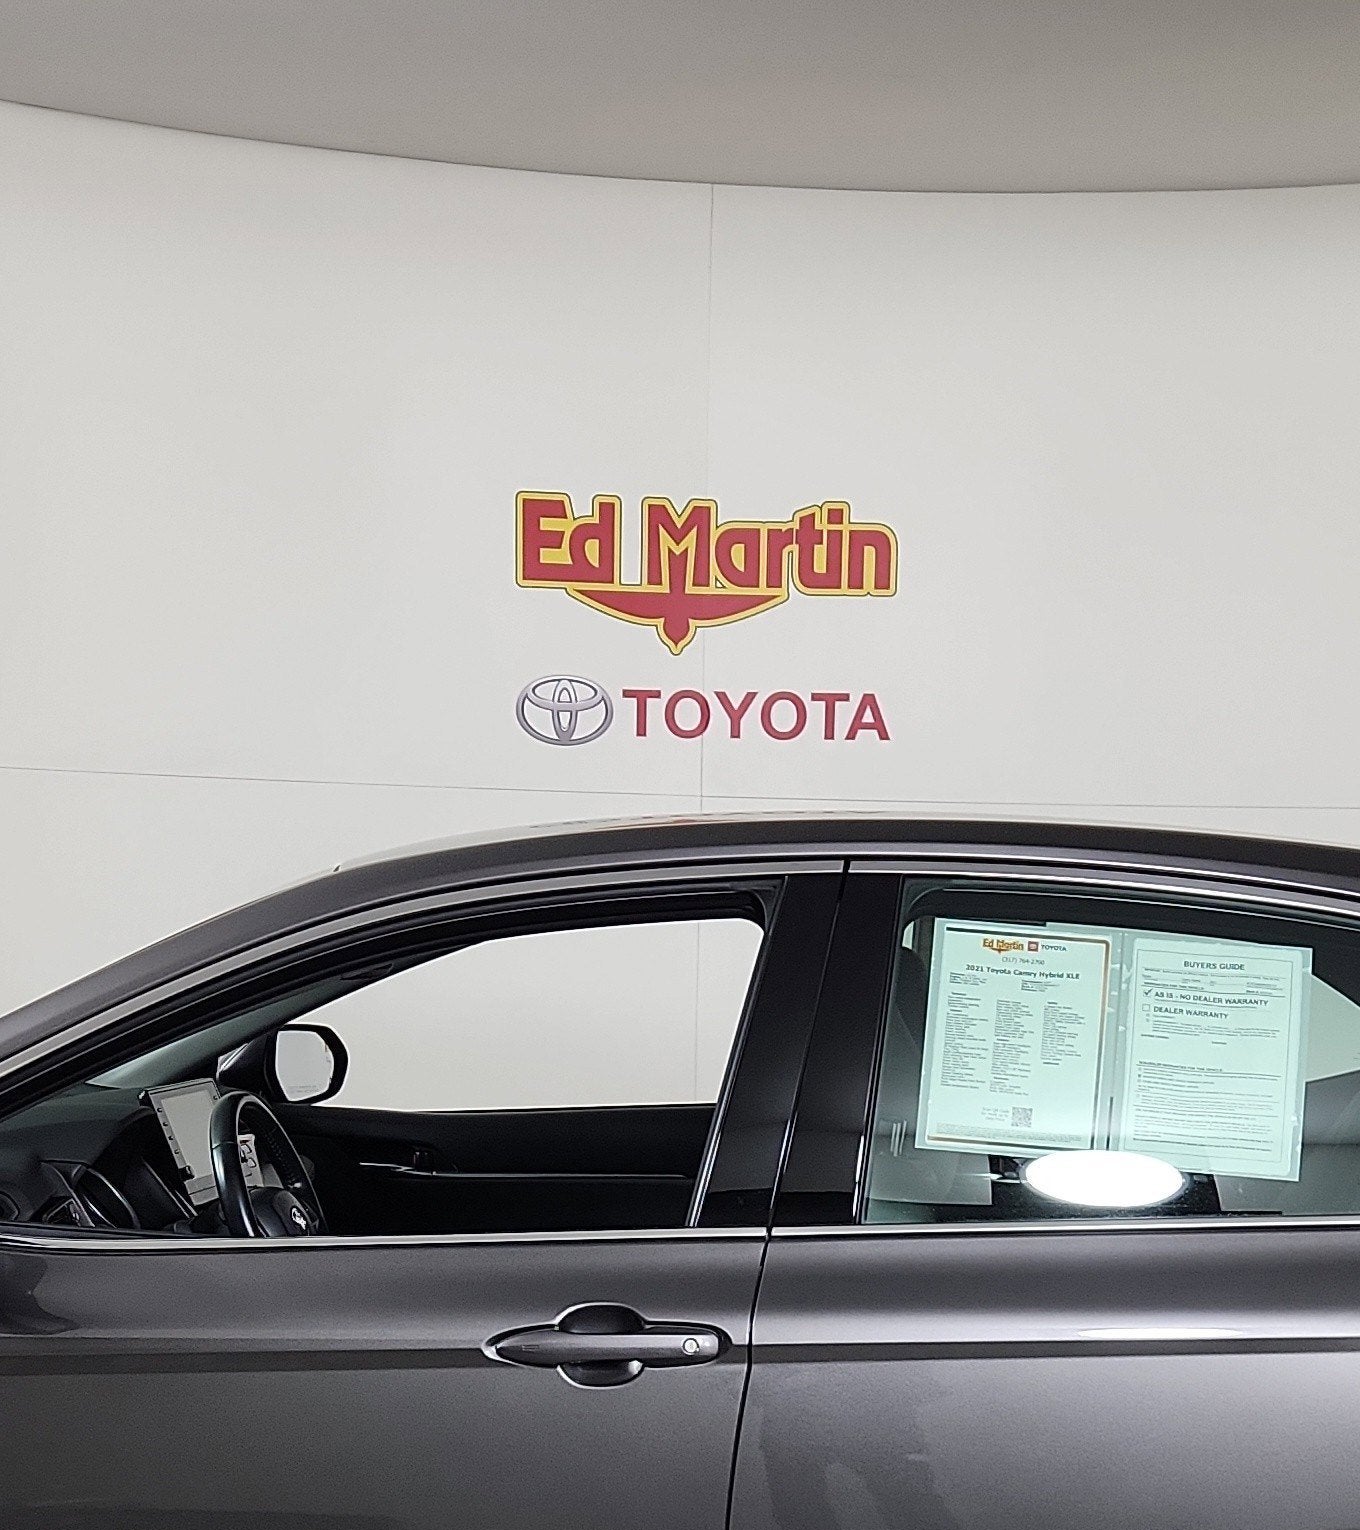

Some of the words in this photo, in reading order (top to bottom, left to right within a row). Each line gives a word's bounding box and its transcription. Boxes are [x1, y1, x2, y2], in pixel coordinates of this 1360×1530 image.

[516, 491, 621, 588] Ed
[642, 496, 898, 597] Martin
[622, 689, 891, 742] TOYOTA
[966, 964, 984, 972] 2021
[987, 967, 1011, 976] Toyota
[1013, 969, 1037, 978] Camry
[1039, 971, 1064, 979] Hybrid
[1184, 961, 1217, 970] BUYERS
[1219, 963, 1245, 971] GUIDE
[1154, 991, 1164, 999] AS
[1192, 995, 1223, 1004] DEALER
[1225, 997, 1269, 1006] WARRANTY
[1153, 1006, 1184, 1015] DEALER
[1185, 1009, 1229, 1019] WARRANTY
